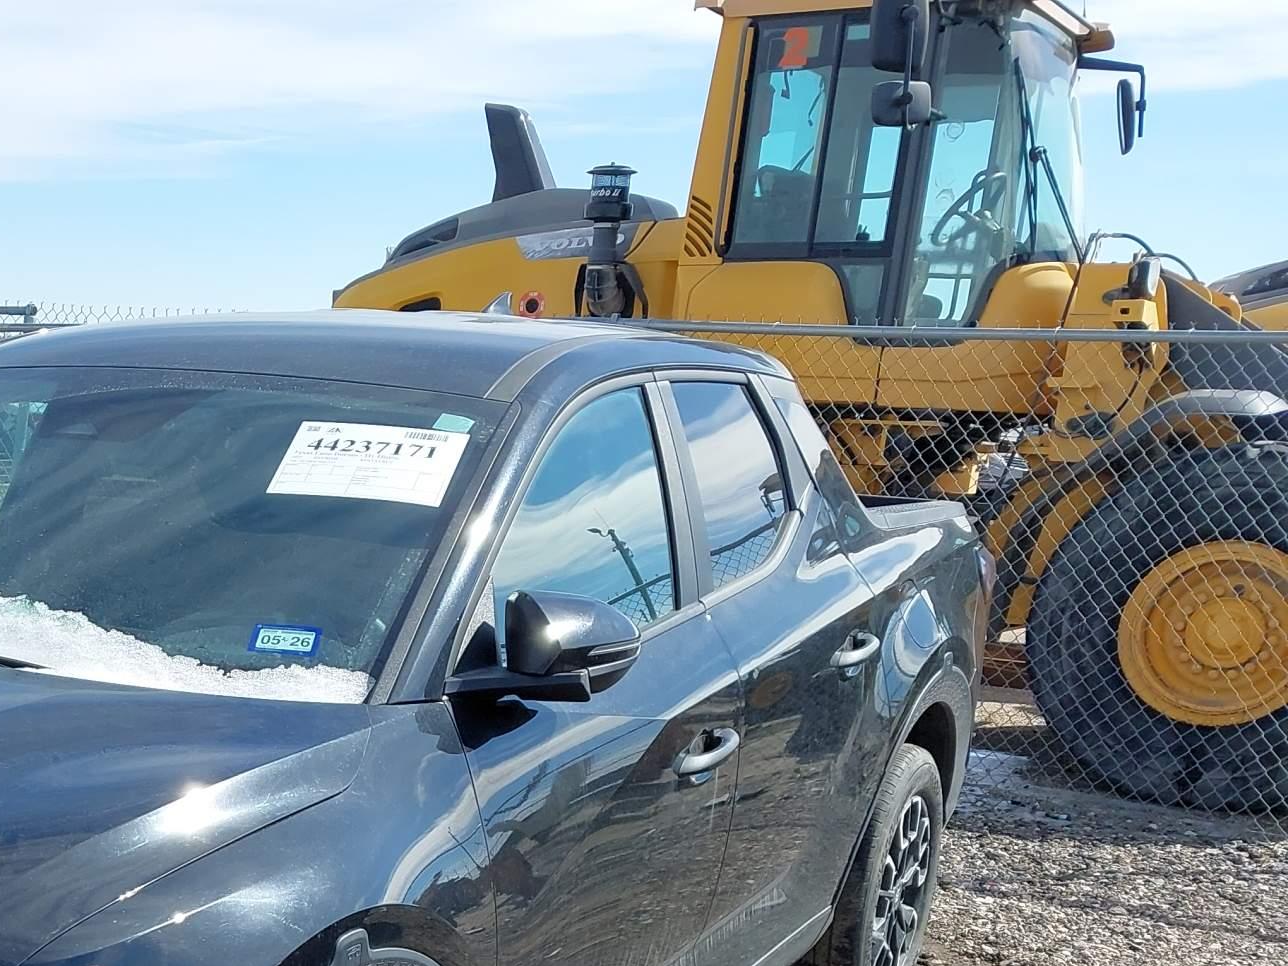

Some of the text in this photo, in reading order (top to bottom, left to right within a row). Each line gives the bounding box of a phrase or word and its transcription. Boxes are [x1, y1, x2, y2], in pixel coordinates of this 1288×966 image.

[778, 26, 809, 69] 2
[591, 187, 611, 197] urbo
[536, 233, 625, 252] VOL
[307, 437, 437, 459] 44237171
[260, 634, 311, 647] 05 26
